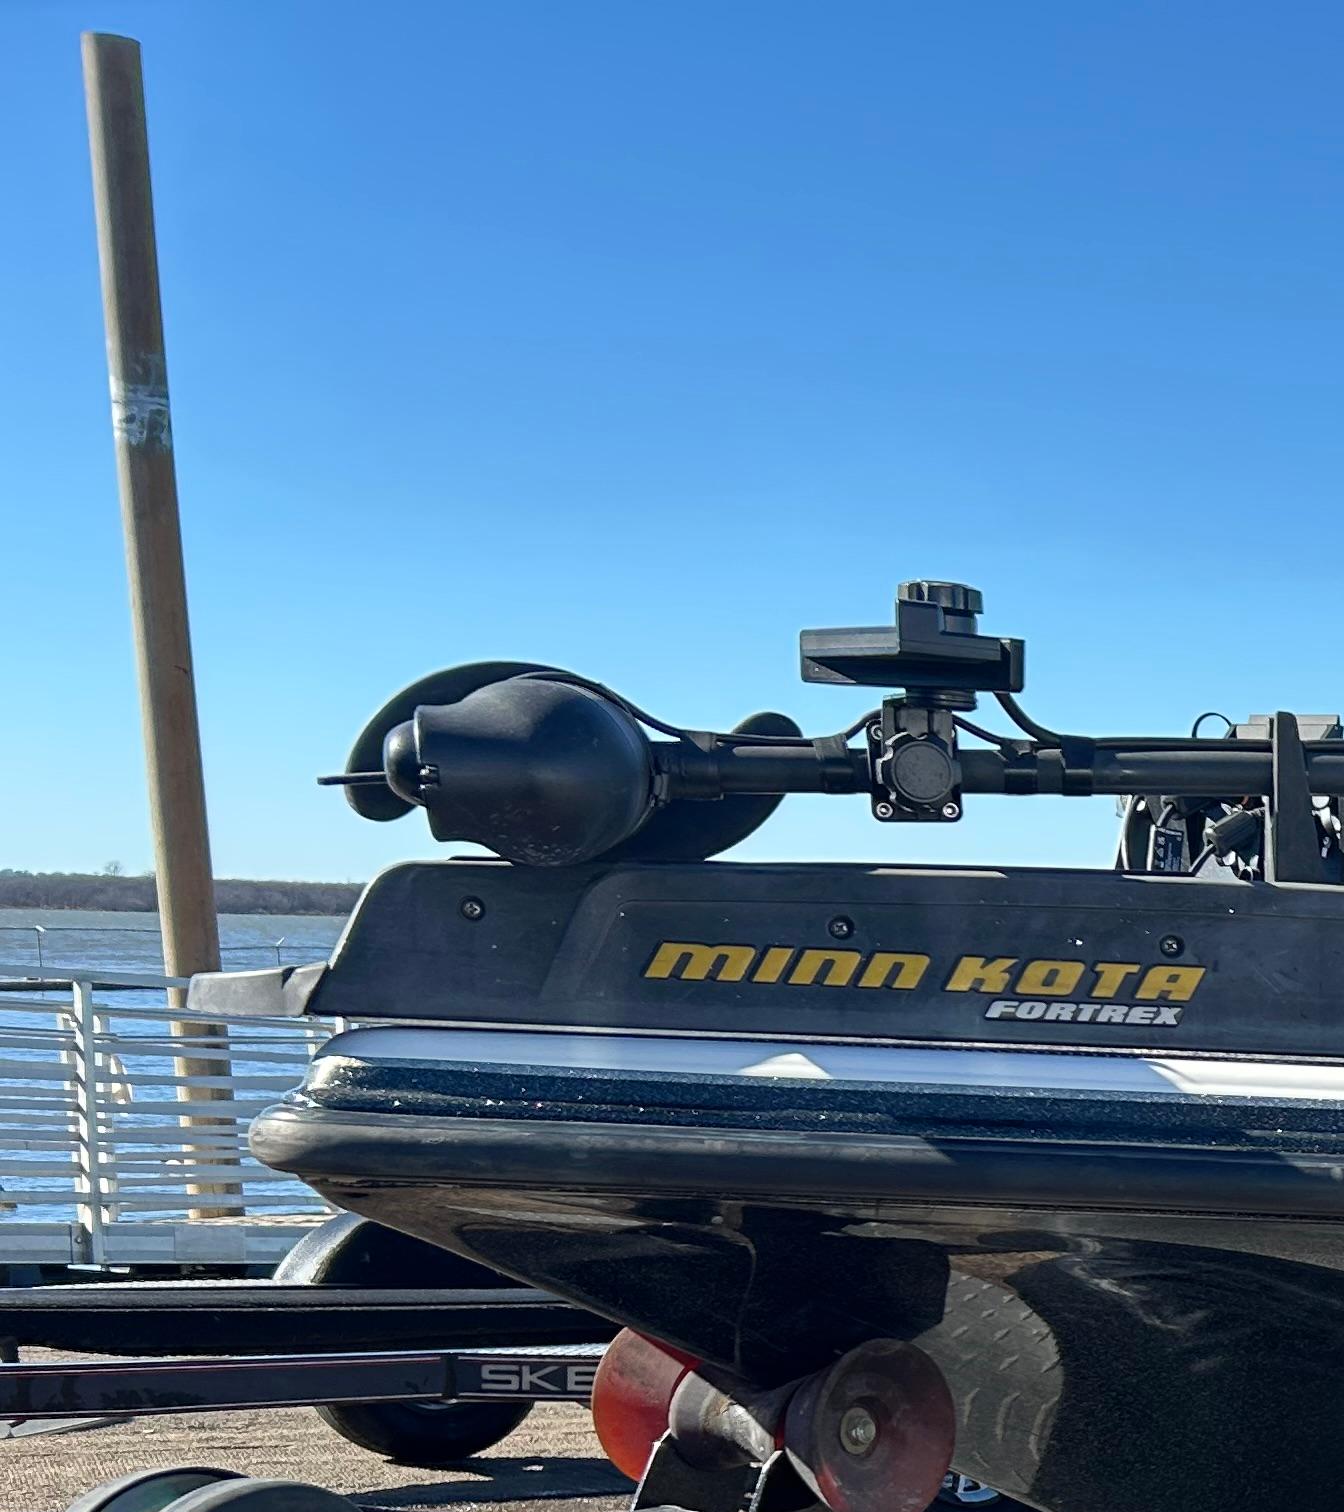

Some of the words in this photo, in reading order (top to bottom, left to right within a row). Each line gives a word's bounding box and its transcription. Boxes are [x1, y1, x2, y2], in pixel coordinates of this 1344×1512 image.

[645, 941, 931, 990] MINN
[944, 955, 1206, 1001] KOTA
[984, 1000, 1184, 1027] FORTREX
